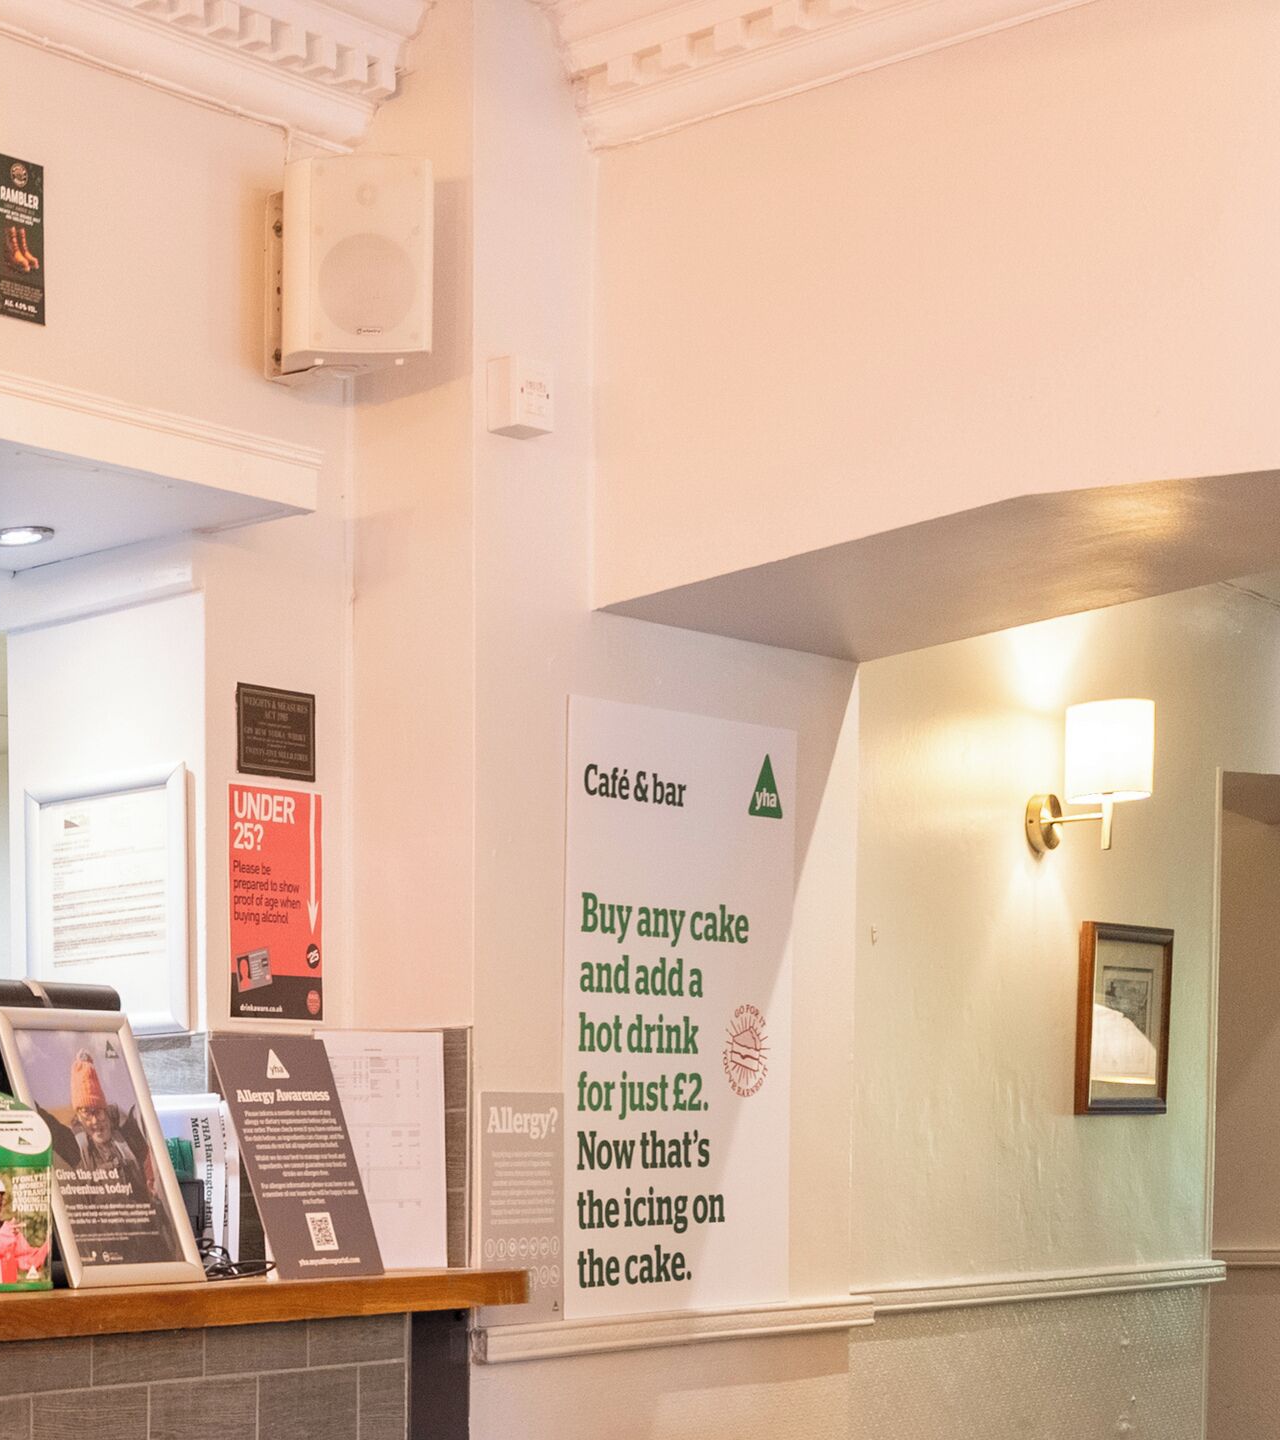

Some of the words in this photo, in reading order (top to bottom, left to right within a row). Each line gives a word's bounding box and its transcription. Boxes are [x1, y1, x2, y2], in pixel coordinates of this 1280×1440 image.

[0, 185, 39, 210] RAMBLER
[584, 763, 630, 800] Café
[633, 770, 648, 803] &
[652, 773, 687, 807] bar
[233, 791, 295, 824] UNDER
[755, 788, 777, 810] yha
[233, 822, 264, 850] 25?
[233, 860, 260, 875] Please
[261, 863, 271, 875] be
[233, 878, 269, 892] prepared
[270, 881, 278, 892] to
[279, 882, 300, 893] show
[233, 893, 255, 906] proof
[256, 895, 263, 906] of
[264, 898, 278, 910] age
[280, 898, 301, 909] when
[233, 909, 260, 926] buying
[261, 912, 289, 924] alcohol
[581, 892, 632, 944] Buy
[636, 905, 685, 947] any
[690, 904, 749, 943] cake
[580, 955, 630, 994] and
[635, 957, 684, 997] add
[689, 966, 703, 998] a
[240, 1003, 283, 1013] drinkaware.co.uk
[734, 1005, 745, 1018] GO
[745, 1004, 760, 1017] FOR
[578, 1012, 622, 1053] hot
[627, 1014, 699, 1054] drink
[270, 1063, 284, 1076] yha
[236, 1089, 276, 1104] Allergy
[276, 1089, 330, 1102] Awareness
[577, 1071, 615, 1111] for
[619, 1071, 668, 1120] just
[672, 1072, 709, 1111] £2.
[191, 1116, 201, 1149] Menu
[201, 1116, 211, 1143] YHA
[487, 1106, 559, 1139] Allergy?
[577, 1131, 635, 1170] Now
[640, 1130, 710, 1169] that's
[56, 1169, 76, 1180] Give
[76, 1169, 92, 1180] the
[93, 1168, 108, 1182] gift
[108, 1168, 119, 1180] of
[203, 1143, 213, 1204] Hartington
[60, 1183, 105, 1195] adventure
[106, 1182, 133, 1196] today!
[204, 1204, 213, 1230] Hall
[577, 1189, 619, 1230] the
[624, 1186, 688, 1234] icing
[692, 1194, 725, 1224] on
[578, 1249, 620, 1288] the
[625, 1244, 692, 1285] cake.
